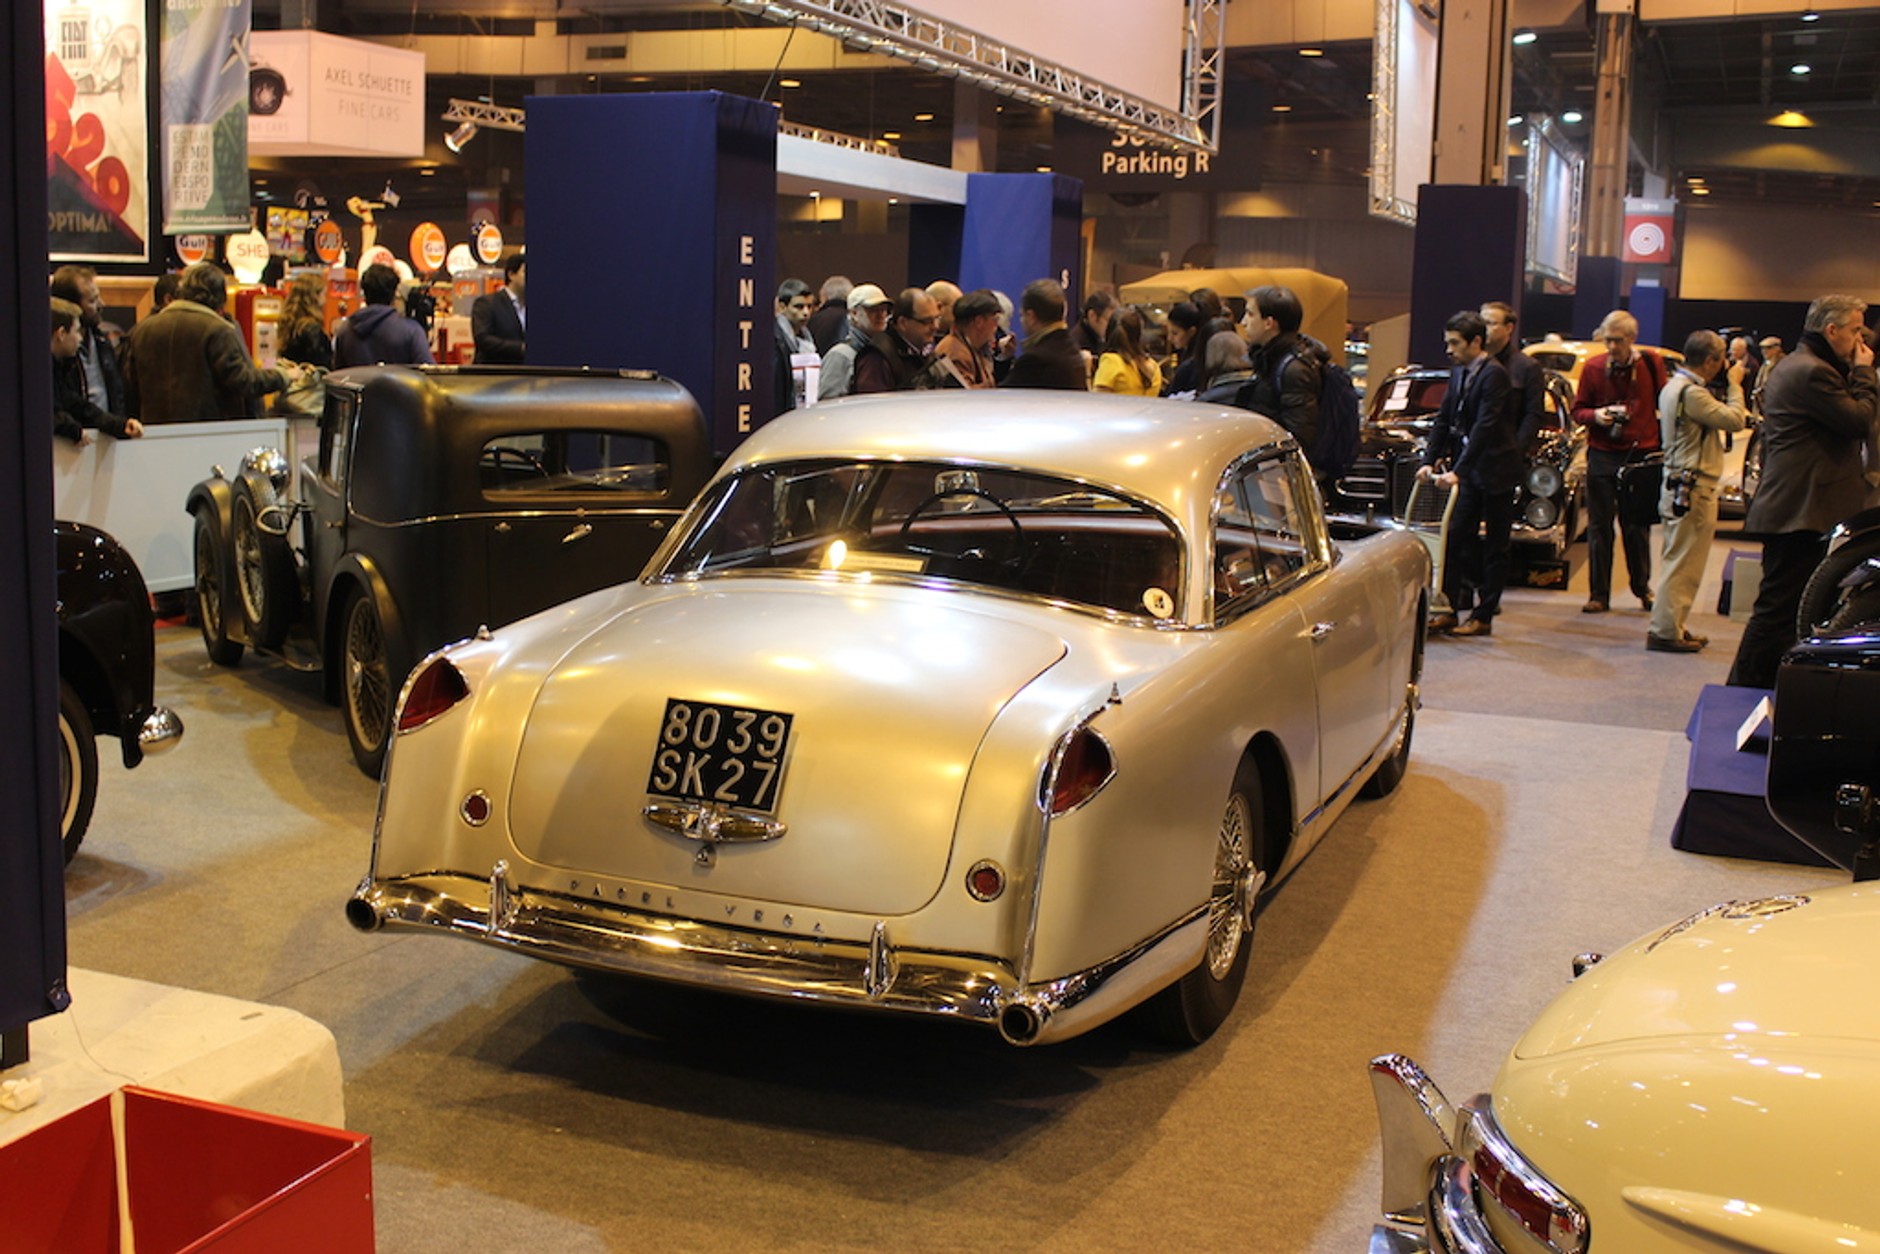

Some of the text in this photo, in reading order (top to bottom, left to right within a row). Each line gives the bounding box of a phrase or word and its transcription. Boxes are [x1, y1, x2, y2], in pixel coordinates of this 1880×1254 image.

[325, 67, 413, 95] AXEL SCHUETTE
[338, 99, 400, 122] FINE CARS
[1102, 150, 1209, 179] Parking R
[724, 903, 825, 934] VEGA
